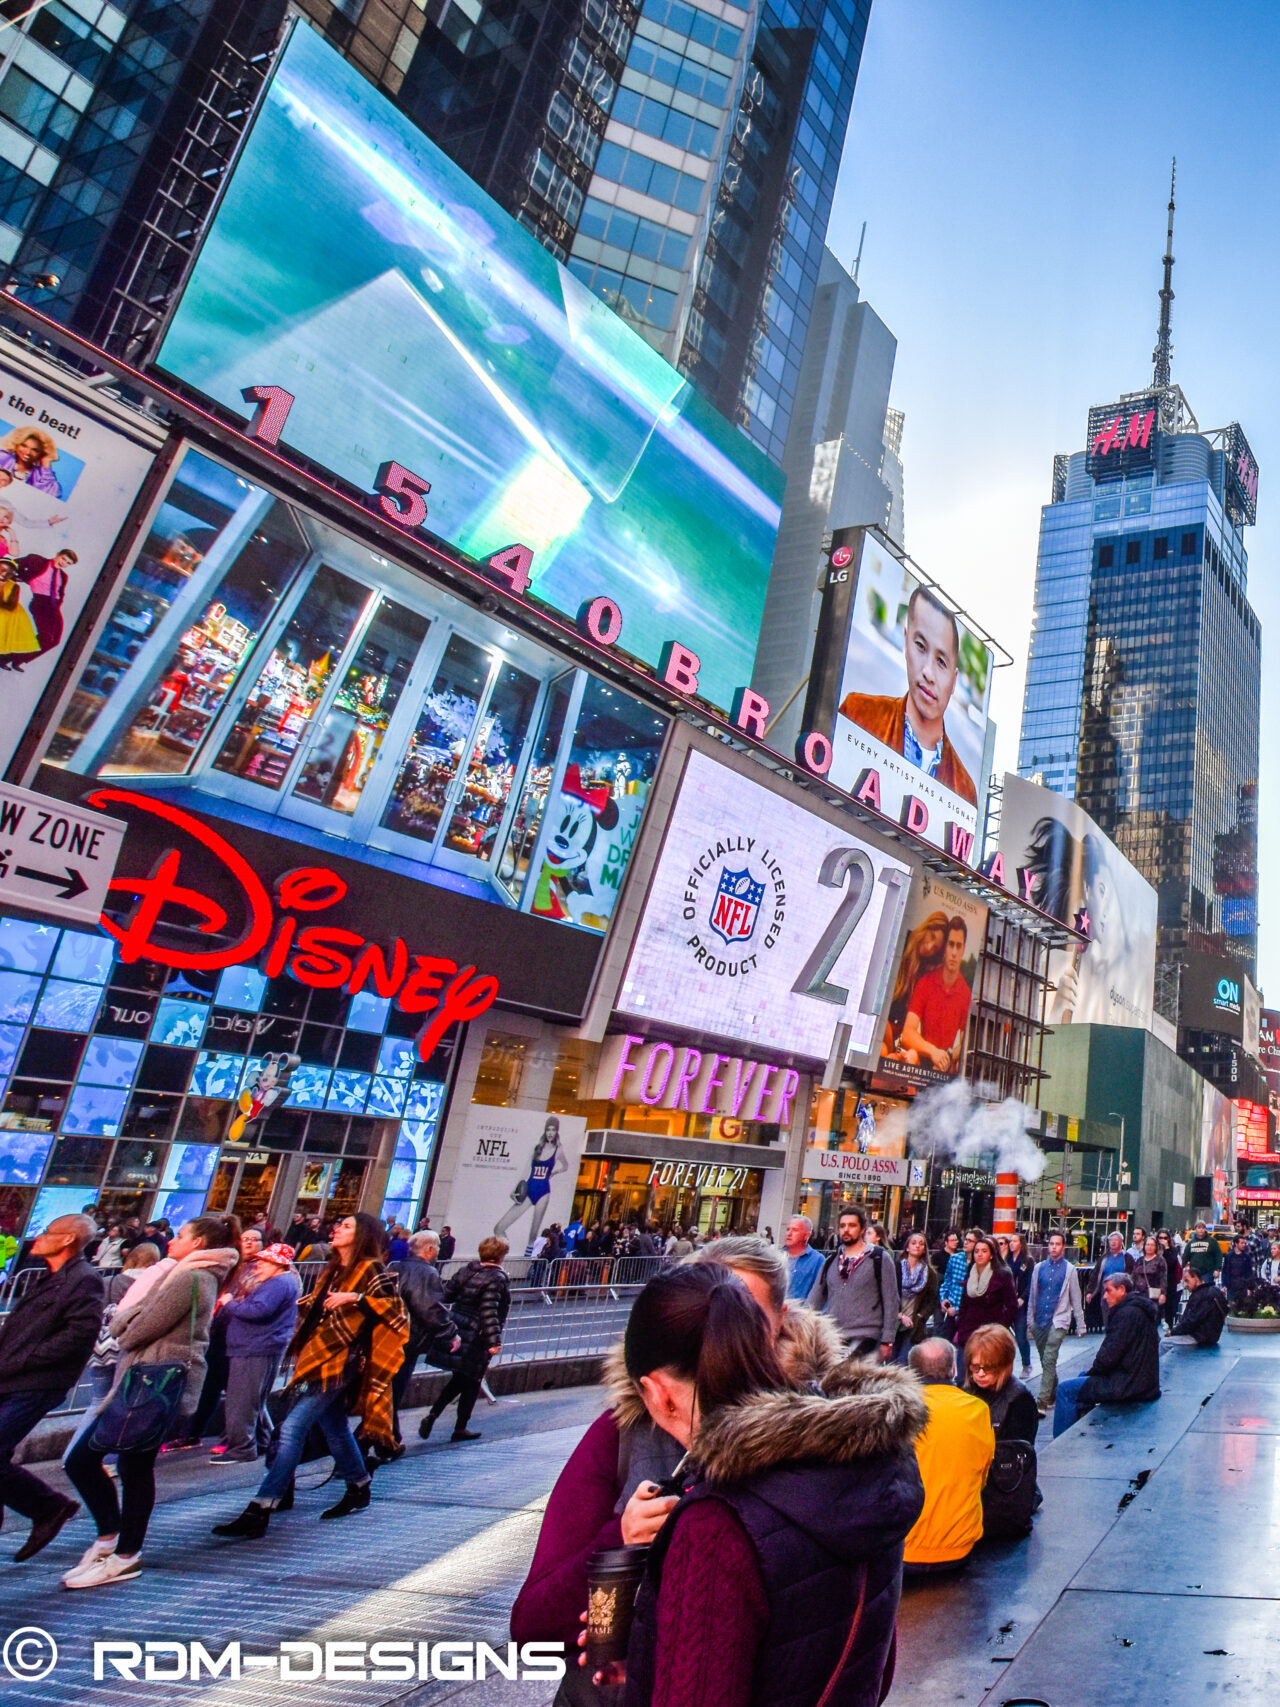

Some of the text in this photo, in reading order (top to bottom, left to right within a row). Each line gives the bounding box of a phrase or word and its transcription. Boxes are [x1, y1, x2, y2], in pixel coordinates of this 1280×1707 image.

[8, 394, 81, 440] the beat!
[241, 385, 623, 645] 1540
[829, 570, 849, 584] LG
[657, 640, 1038, 901] BROADWAY
[847, 733, 879, 759] EVERY
[882, 758, 915, 784] ARTIST
[919, 782, 935, 797] HAS
[30, 811, 105, 860] ZONE
[683, 836, 756, 920] OFFICIALLY
[760, 849, 786, 950] LICENSED
[713, 895, 752, 936] NFL
[686, 934, 759, 977] PRODUCT
[1217, 979, 1240, 1003] ON
[610, 1034, 800, 1125] FOREVER
[884, 1060, 900, 1070] LIVE
[902, 1065, 950, 1081] AUTHENTICALLY
[476, 1139, 510, 1158] NFL
[820, 1153, 899, 1174] U.S. POLO ASSN.
[647, 1161, 749, 1190] FOREVER 21
[838, 1172, 861, 1180] SINCE
